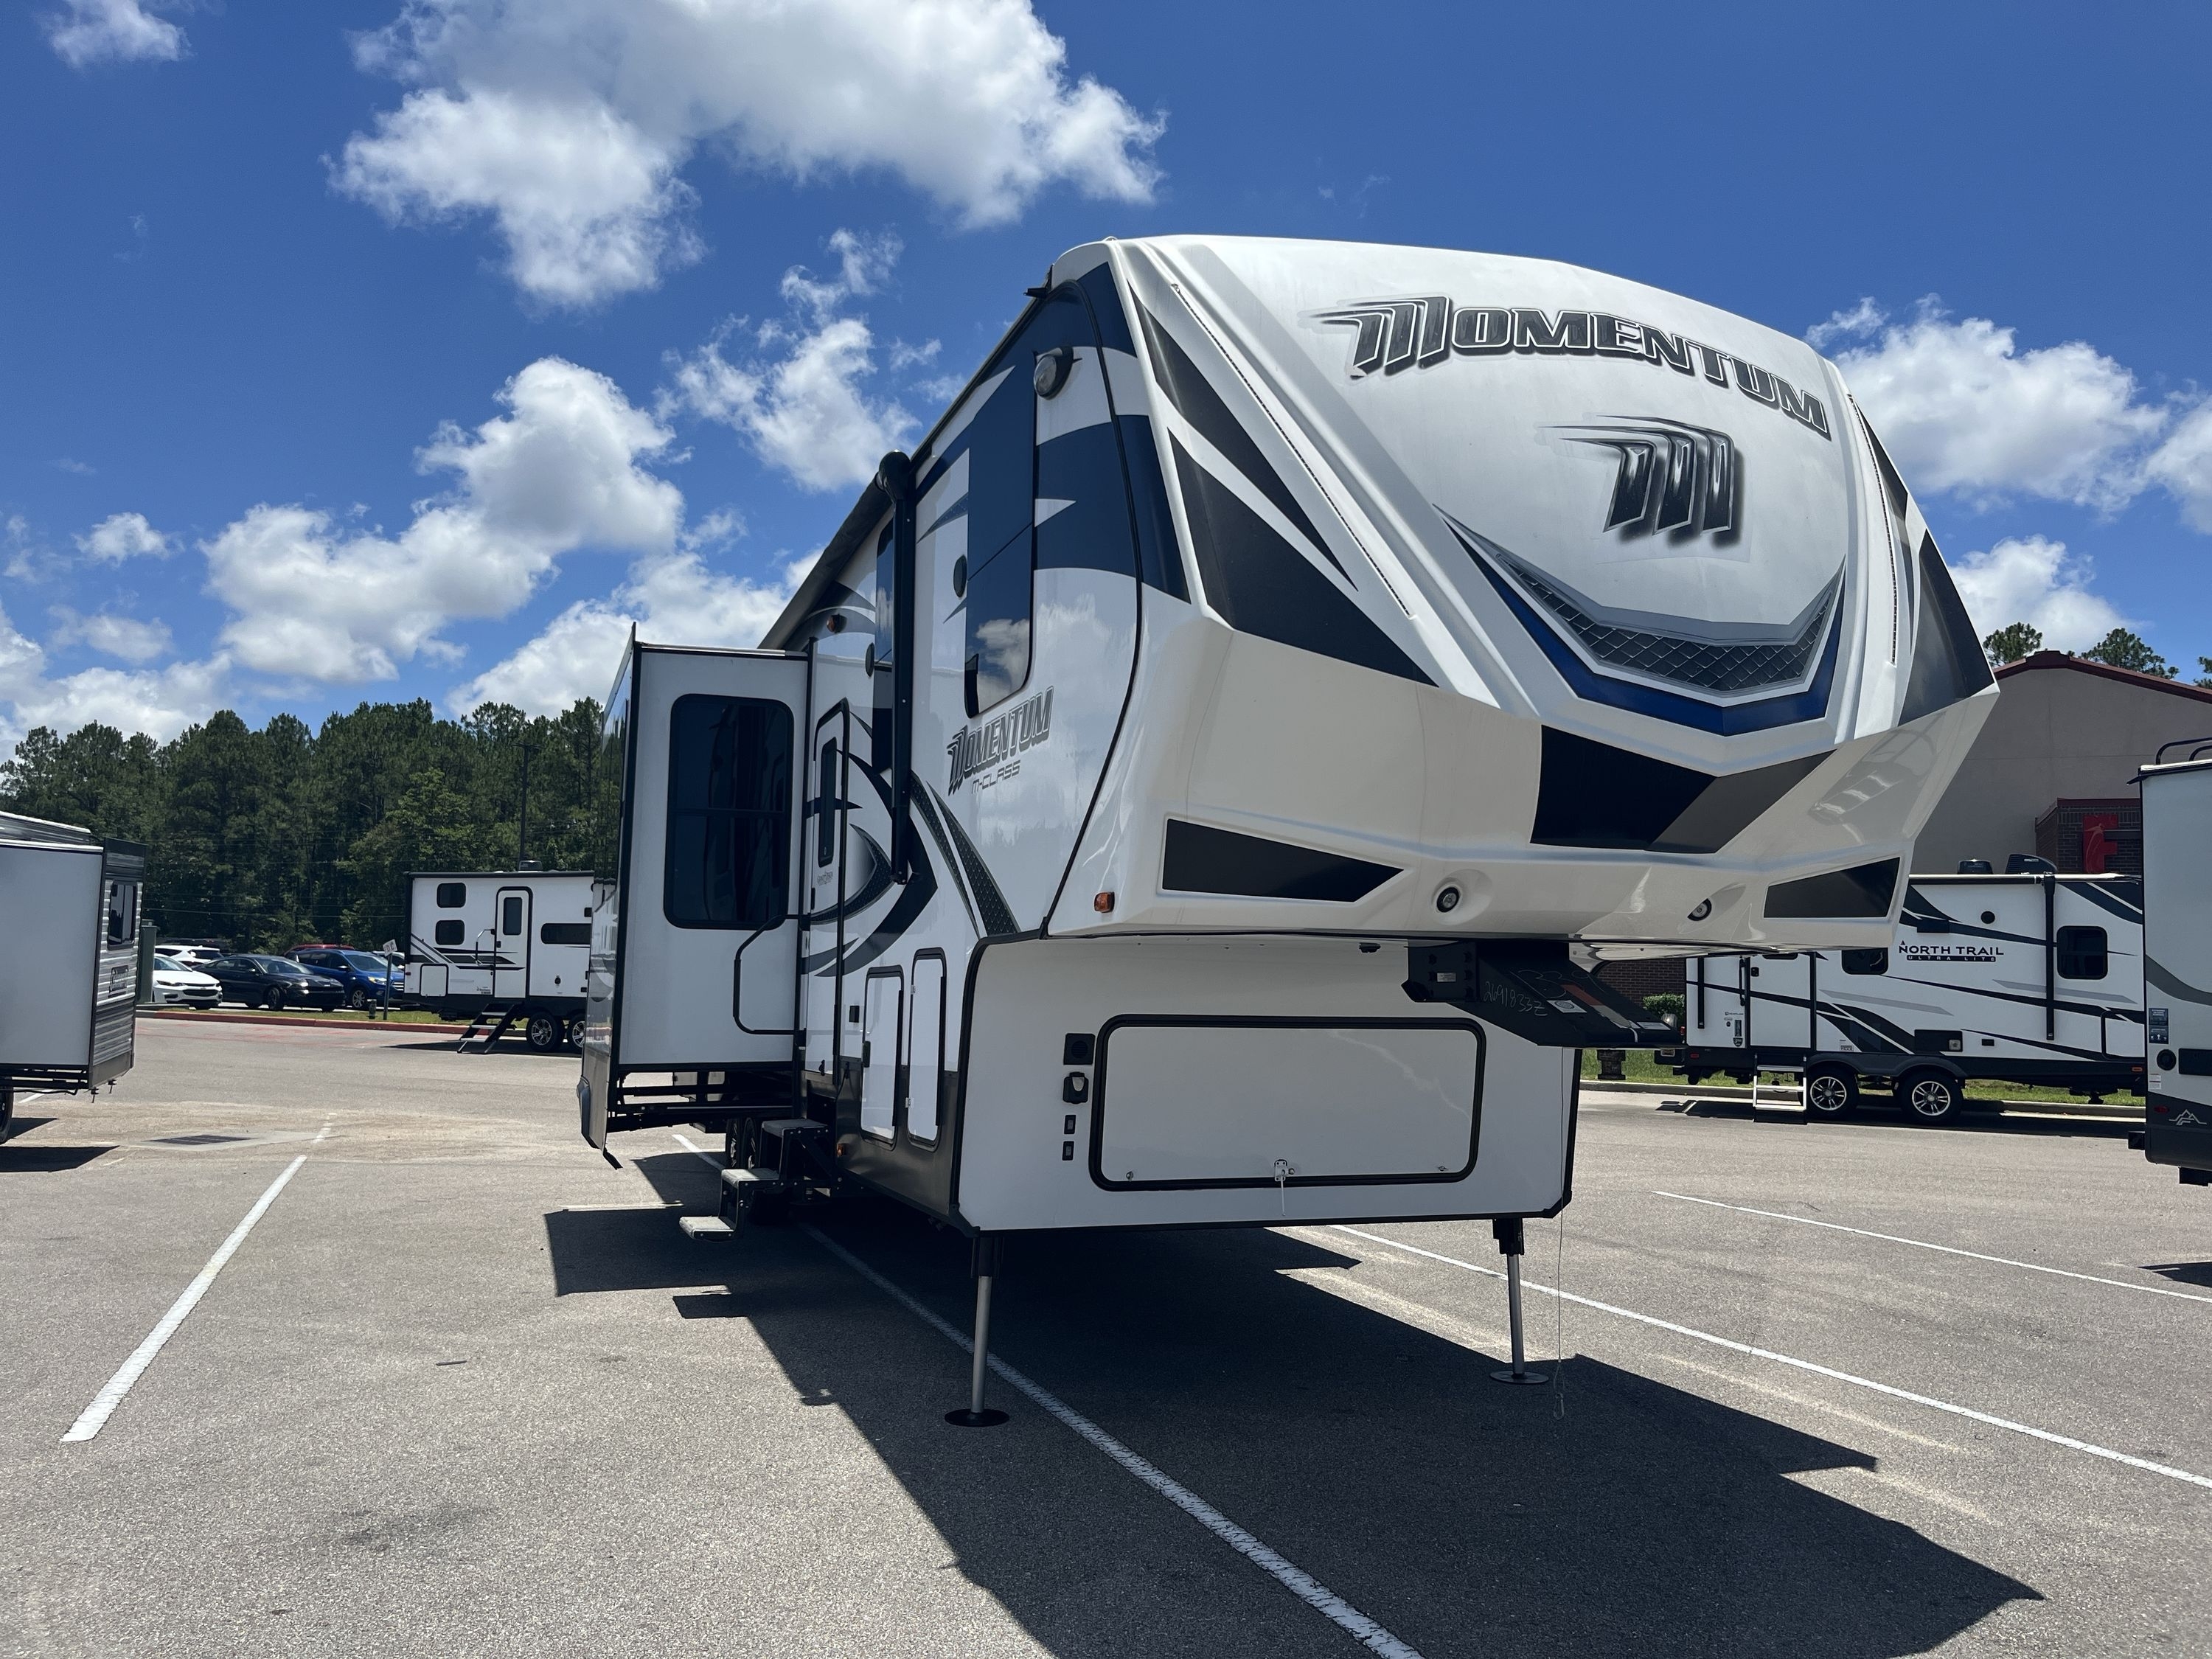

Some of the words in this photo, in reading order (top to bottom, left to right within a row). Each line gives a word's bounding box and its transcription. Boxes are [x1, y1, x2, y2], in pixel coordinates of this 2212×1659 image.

[1311, 296, 1831, 440] MOMENTUM
[947, 686, 1054, 796] MOMENTUM
[1899, 943, 1951, 954] NORTH
[1956, 947, 2004, 956] TRAIL
